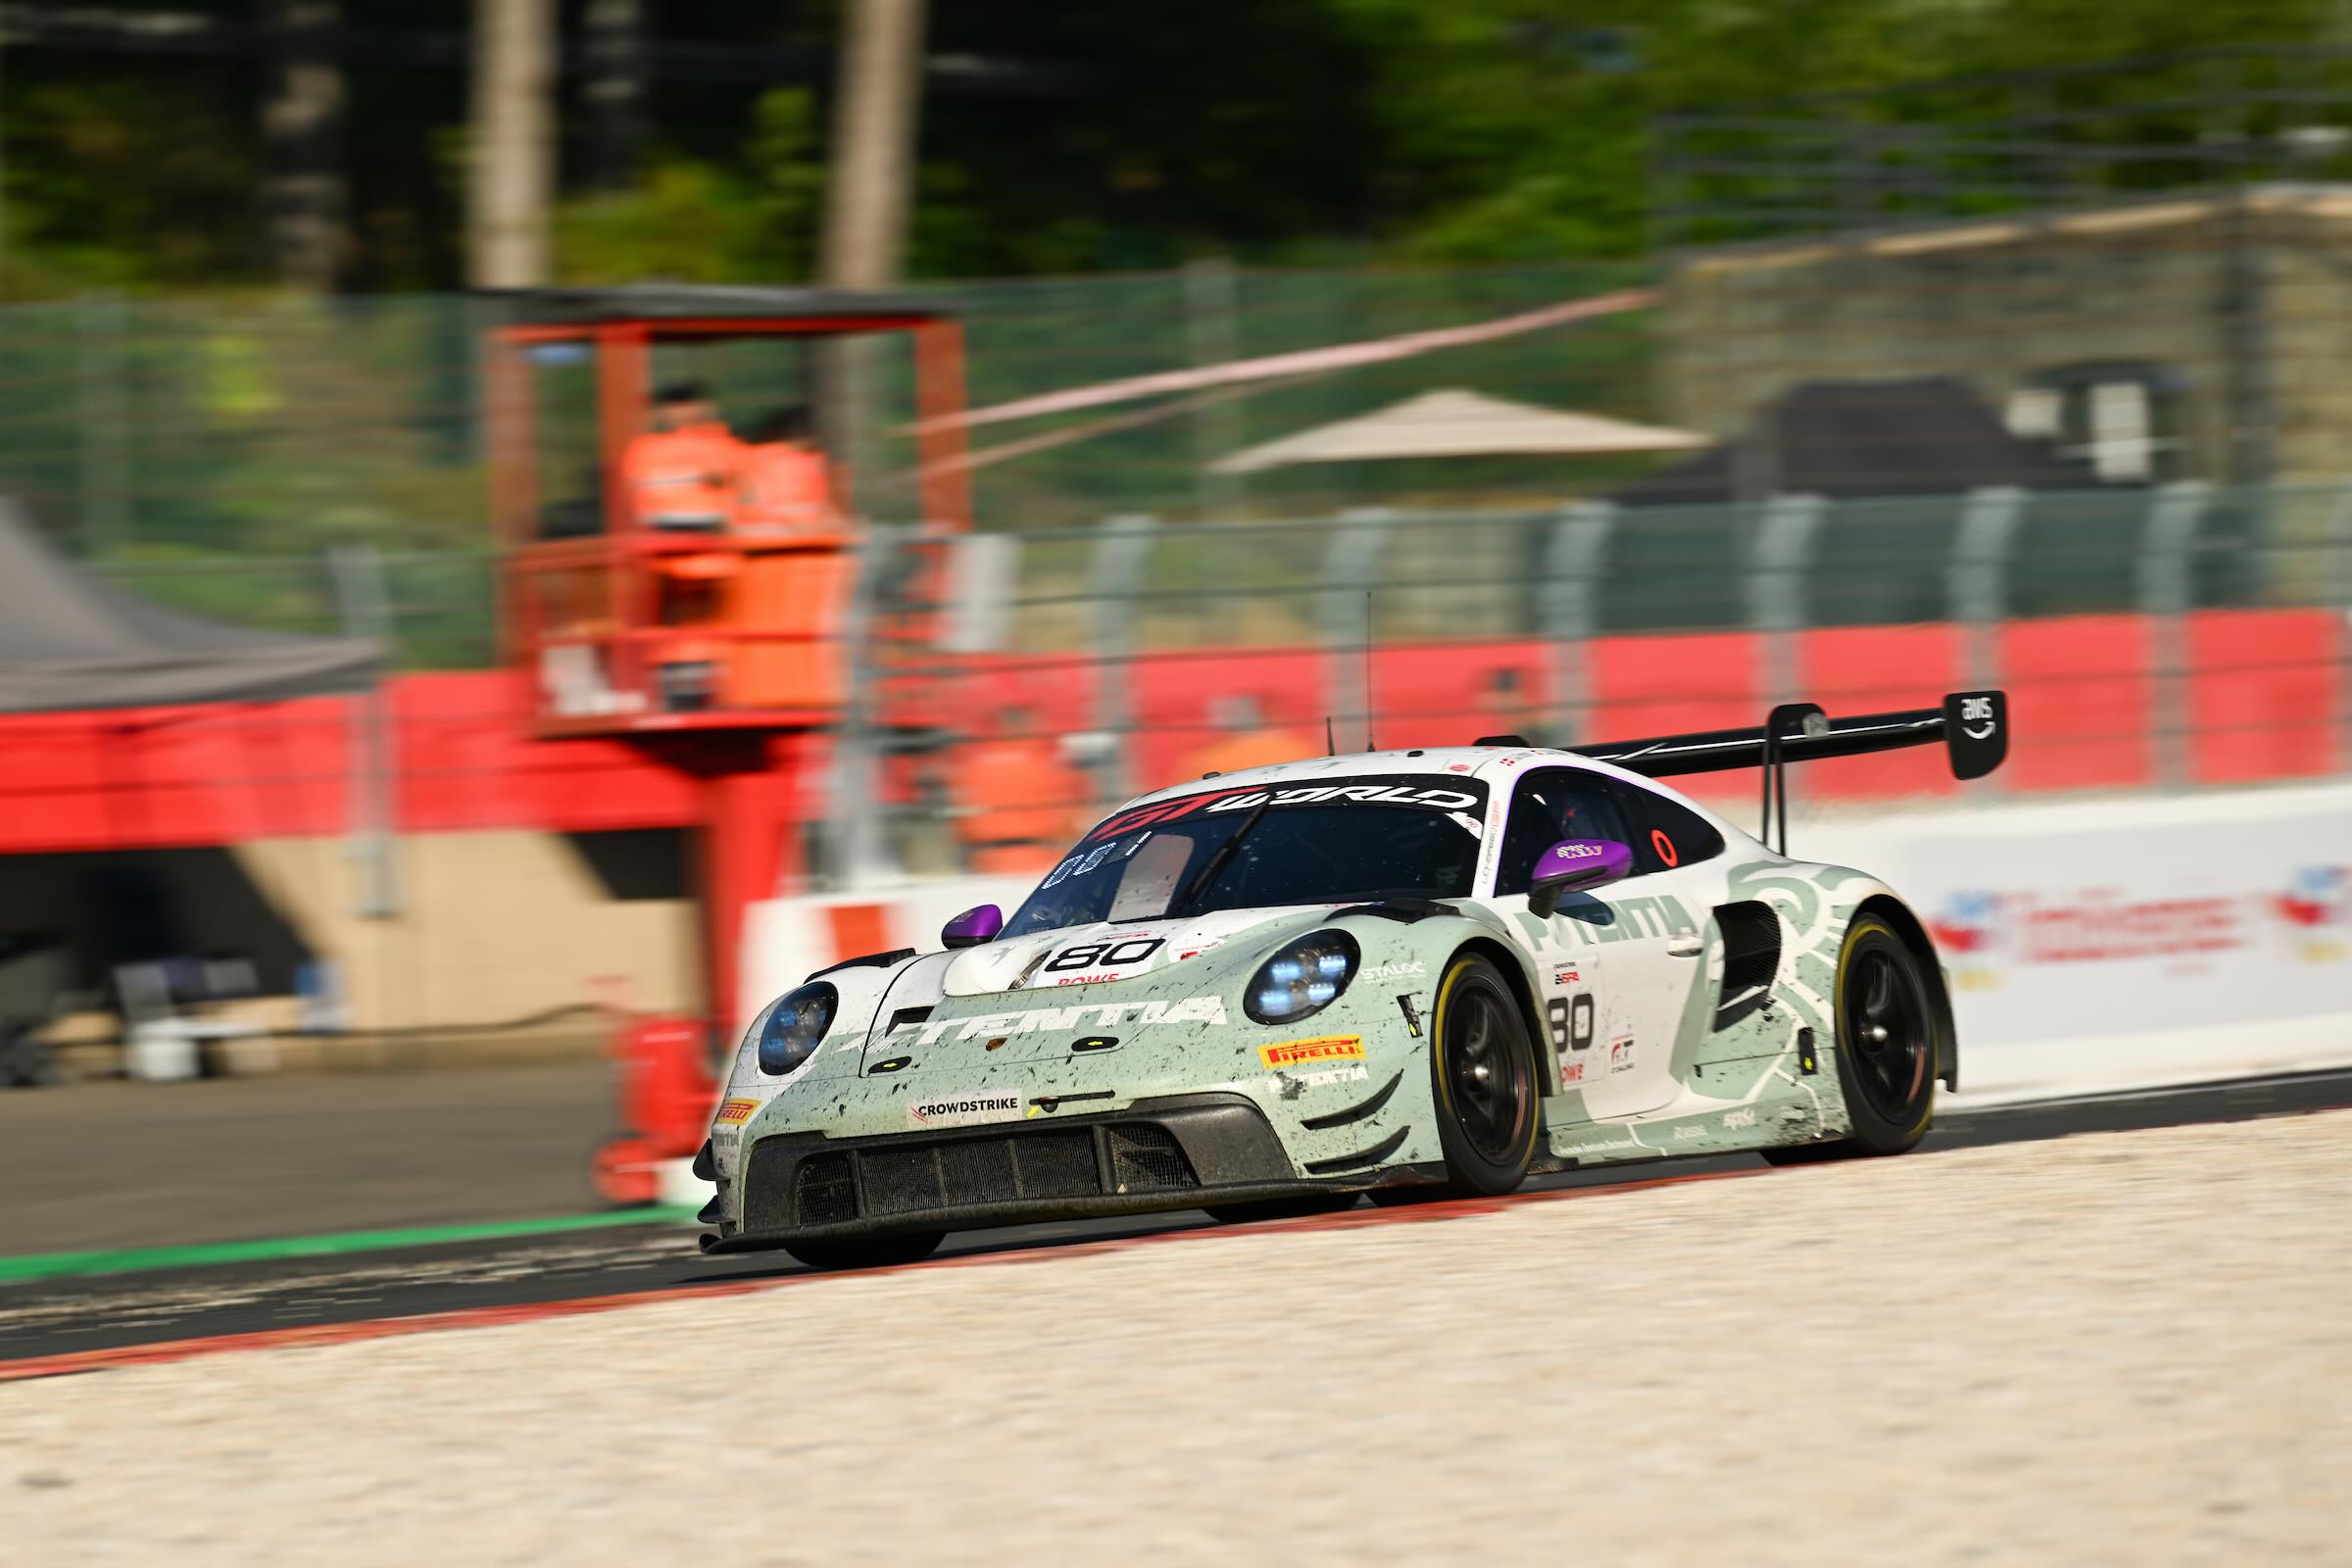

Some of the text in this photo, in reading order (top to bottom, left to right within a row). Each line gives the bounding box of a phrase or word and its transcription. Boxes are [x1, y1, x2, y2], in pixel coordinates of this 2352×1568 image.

[1044, 938, 1167, 972] 80
[1546, 993, 1594, 1054] 80
[1267, 1039, 1357, 1064] PIRELLI
[917, 1097, 1018, 1117] CROWDSTRIKE
